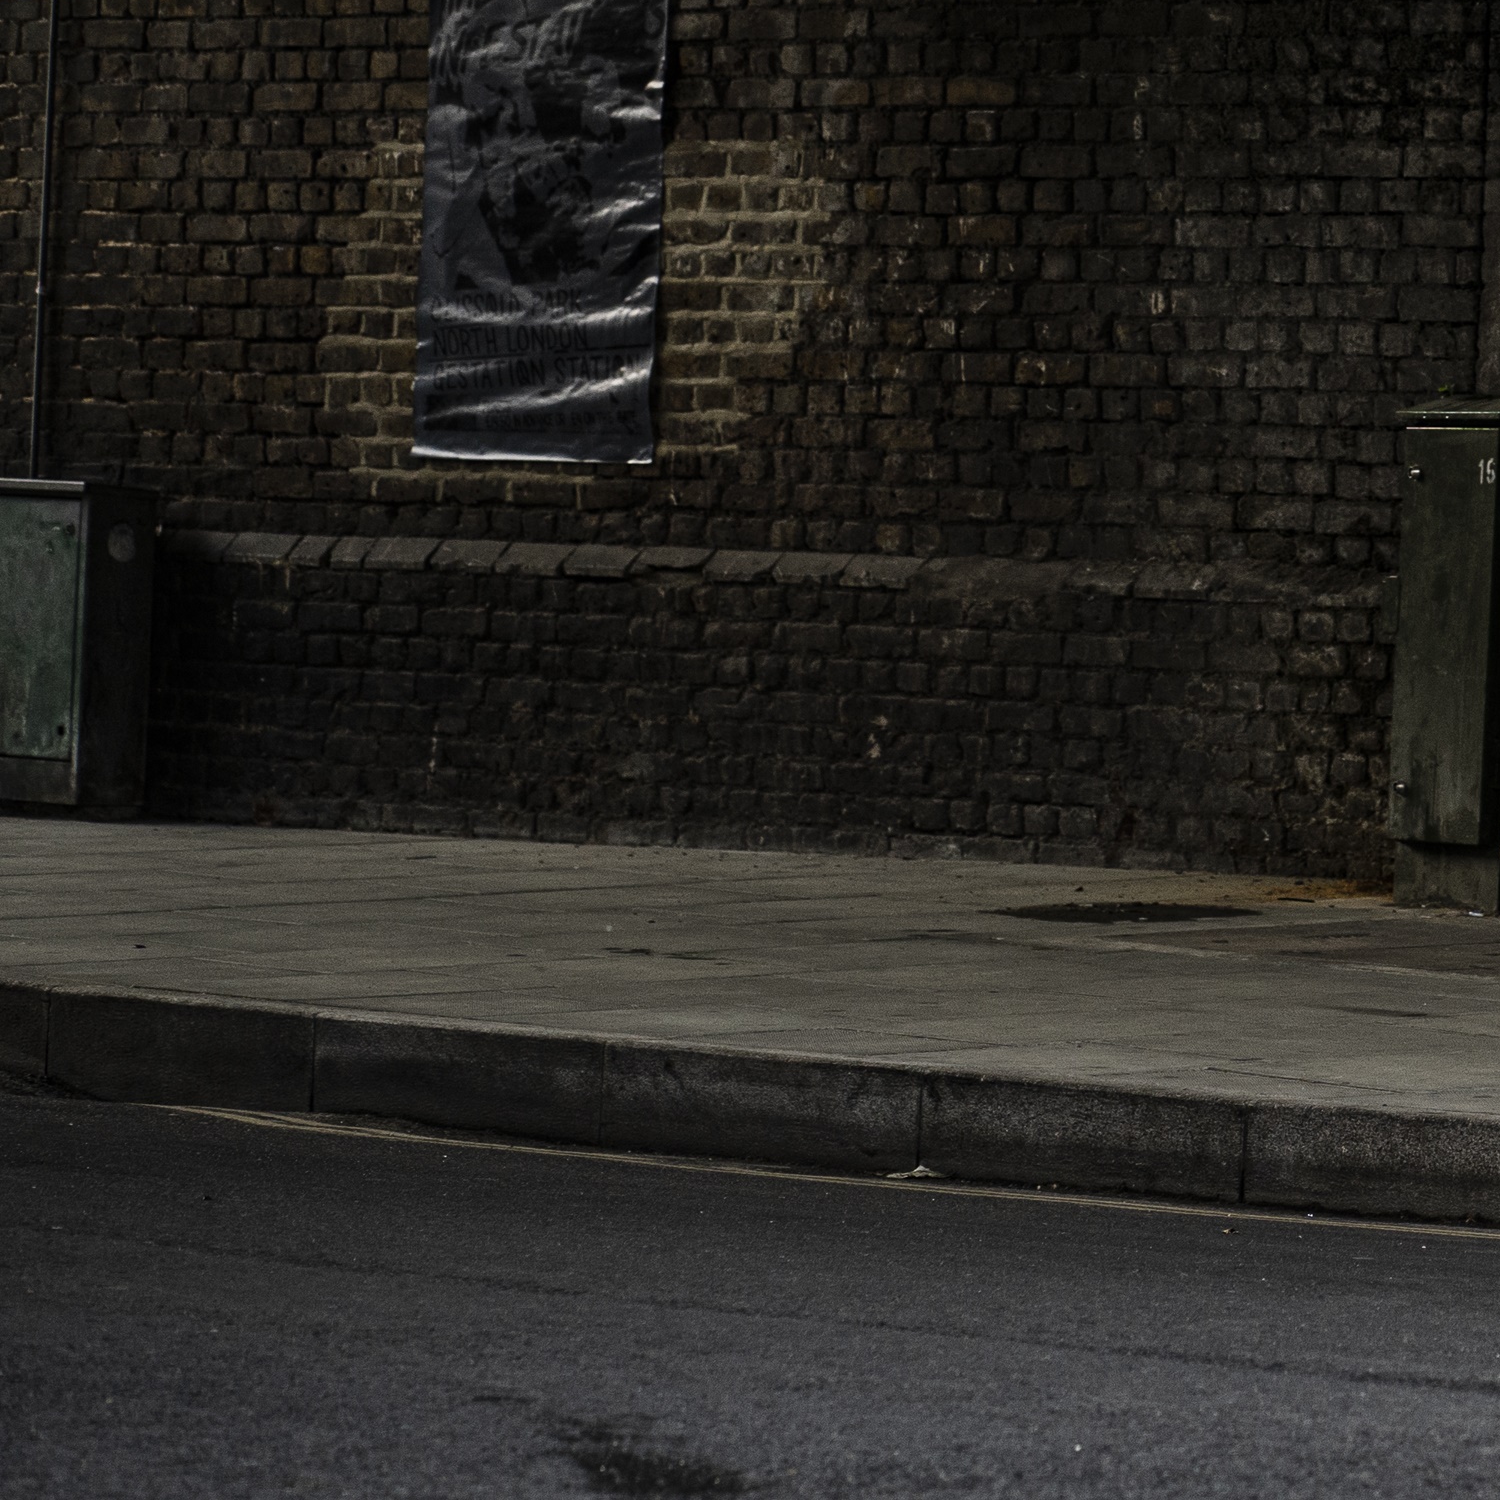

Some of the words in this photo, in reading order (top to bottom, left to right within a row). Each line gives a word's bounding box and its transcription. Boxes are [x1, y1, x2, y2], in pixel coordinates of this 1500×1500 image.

[431, 326, 498, 357] NORTH
[506, 322, 588, 352] LONDON
[432, 359, 546, 391] GESTATION
[553, 354, 641, 384] STATION
